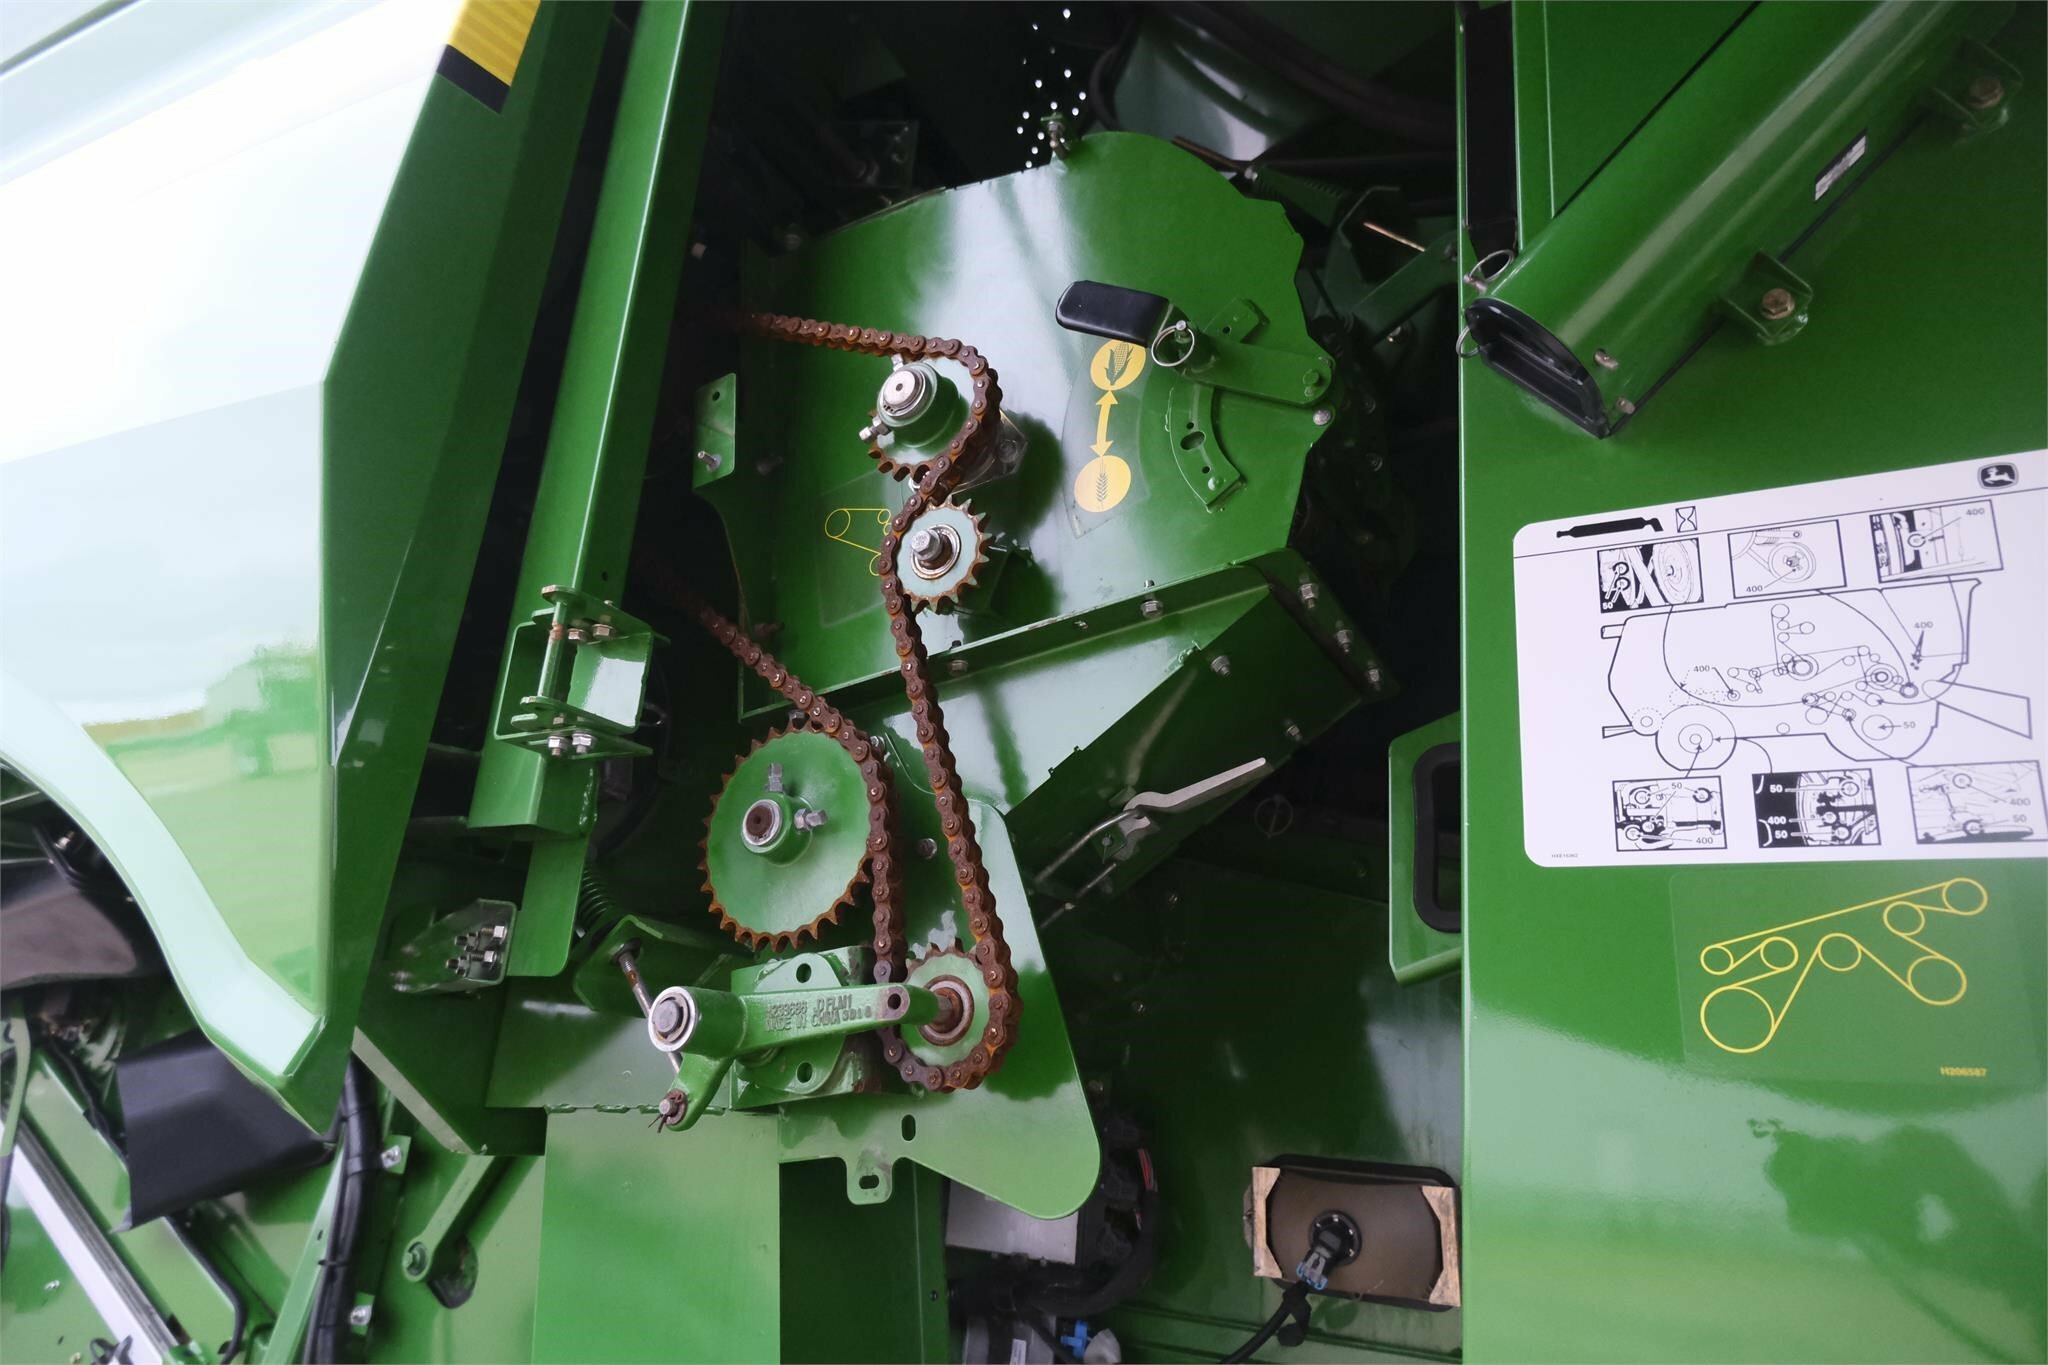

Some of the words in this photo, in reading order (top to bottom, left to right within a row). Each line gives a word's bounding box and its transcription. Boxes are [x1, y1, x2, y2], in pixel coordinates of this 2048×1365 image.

[1966, 508, 1985, 516] 400
[1746, 585, 1763, 593] 400
[1602, 601, 1614, 610] 50
[1914, 621, 1934, 629] 400
[1693, 665, 1710, 673] 400
[1903, 721, 1916, 729] 50
[1671, 782, 1683, 790] 50
[1769, 784, 1783, 793] 50
[2009, 798, 2031, 806] 400
[1767, 816, 1787, 825] 400
[2013, 814, 2027, 823] 50
[1774, 830, 1788, 839] 50
[1696, 836, 1714, 845] 400
[811, 1009, 841, 1027] CHINA
